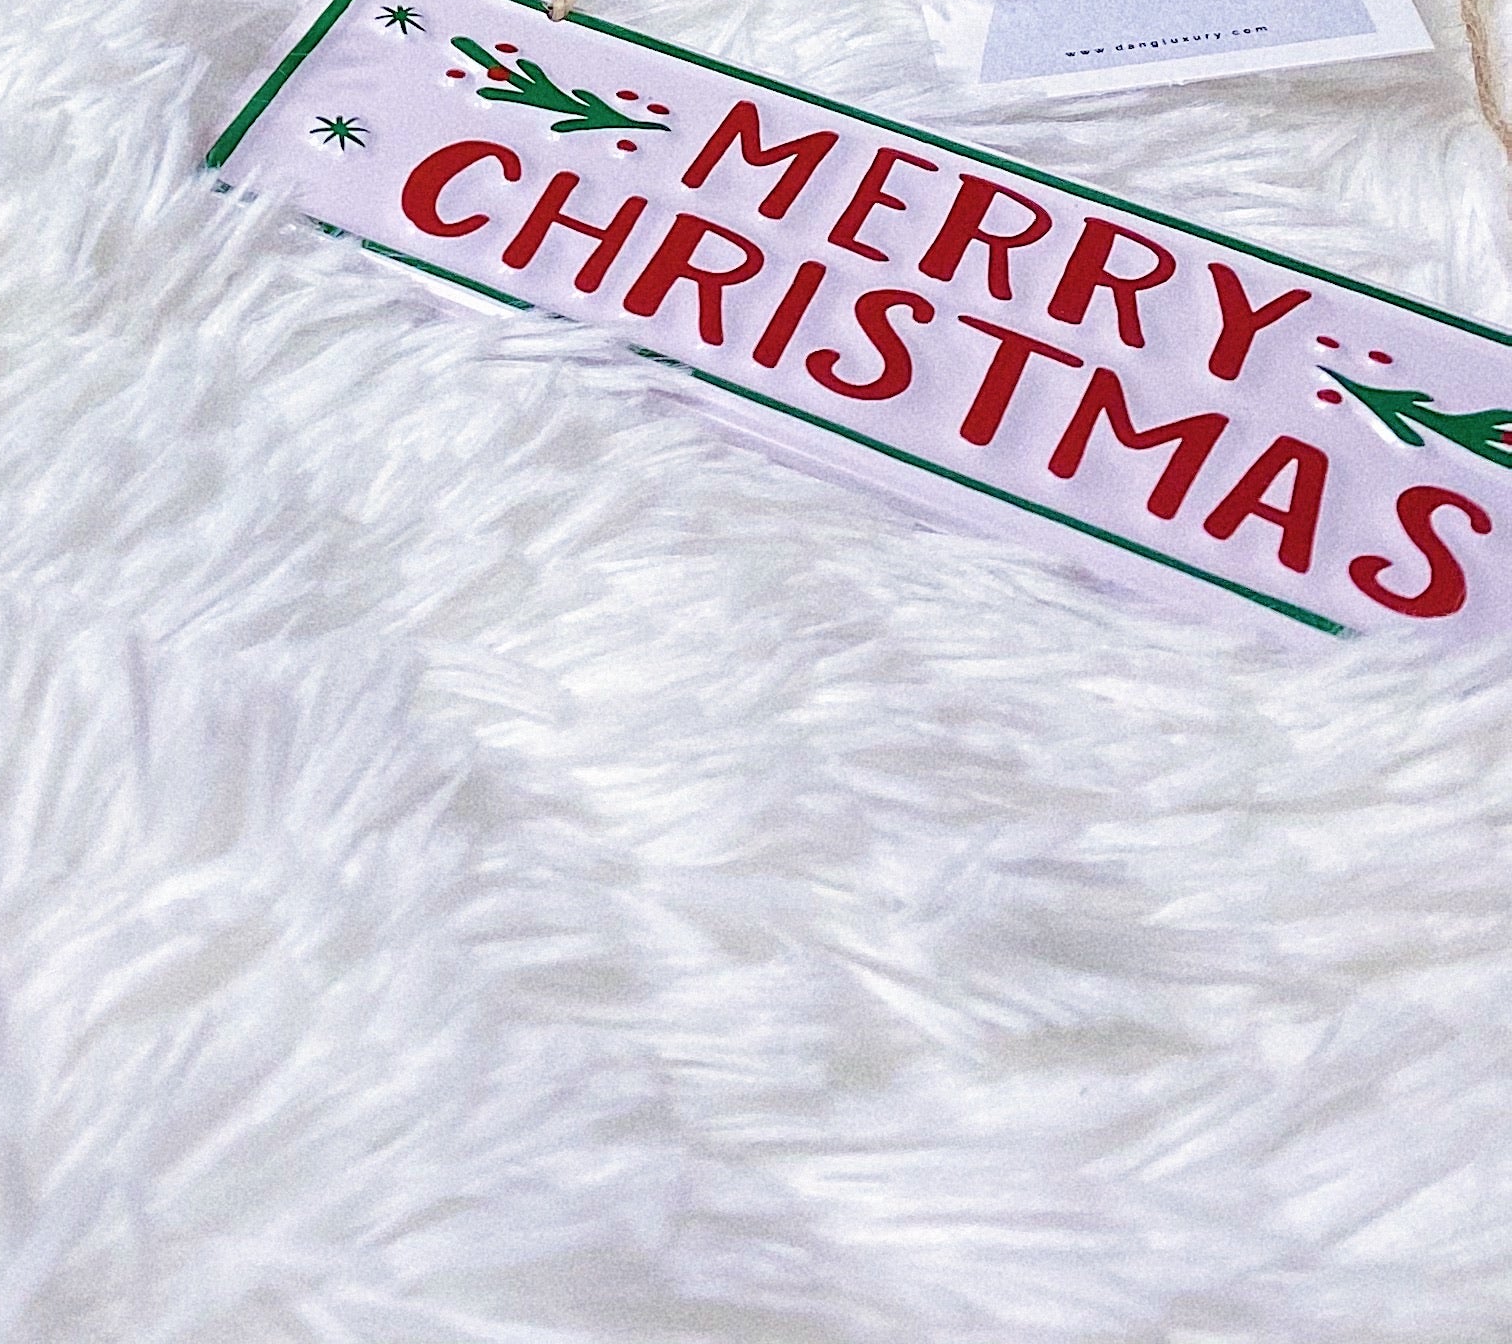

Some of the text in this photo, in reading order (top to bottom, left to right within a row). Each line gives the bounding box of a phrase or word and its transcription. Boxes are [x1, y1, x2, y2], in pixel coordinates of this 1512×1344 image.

[1065, 25, 1268, 57] wwwdangluxurycom
[401, 140, 1491, 618] CHRISTMAS
[683, 100, 1310, 380] MERRY
